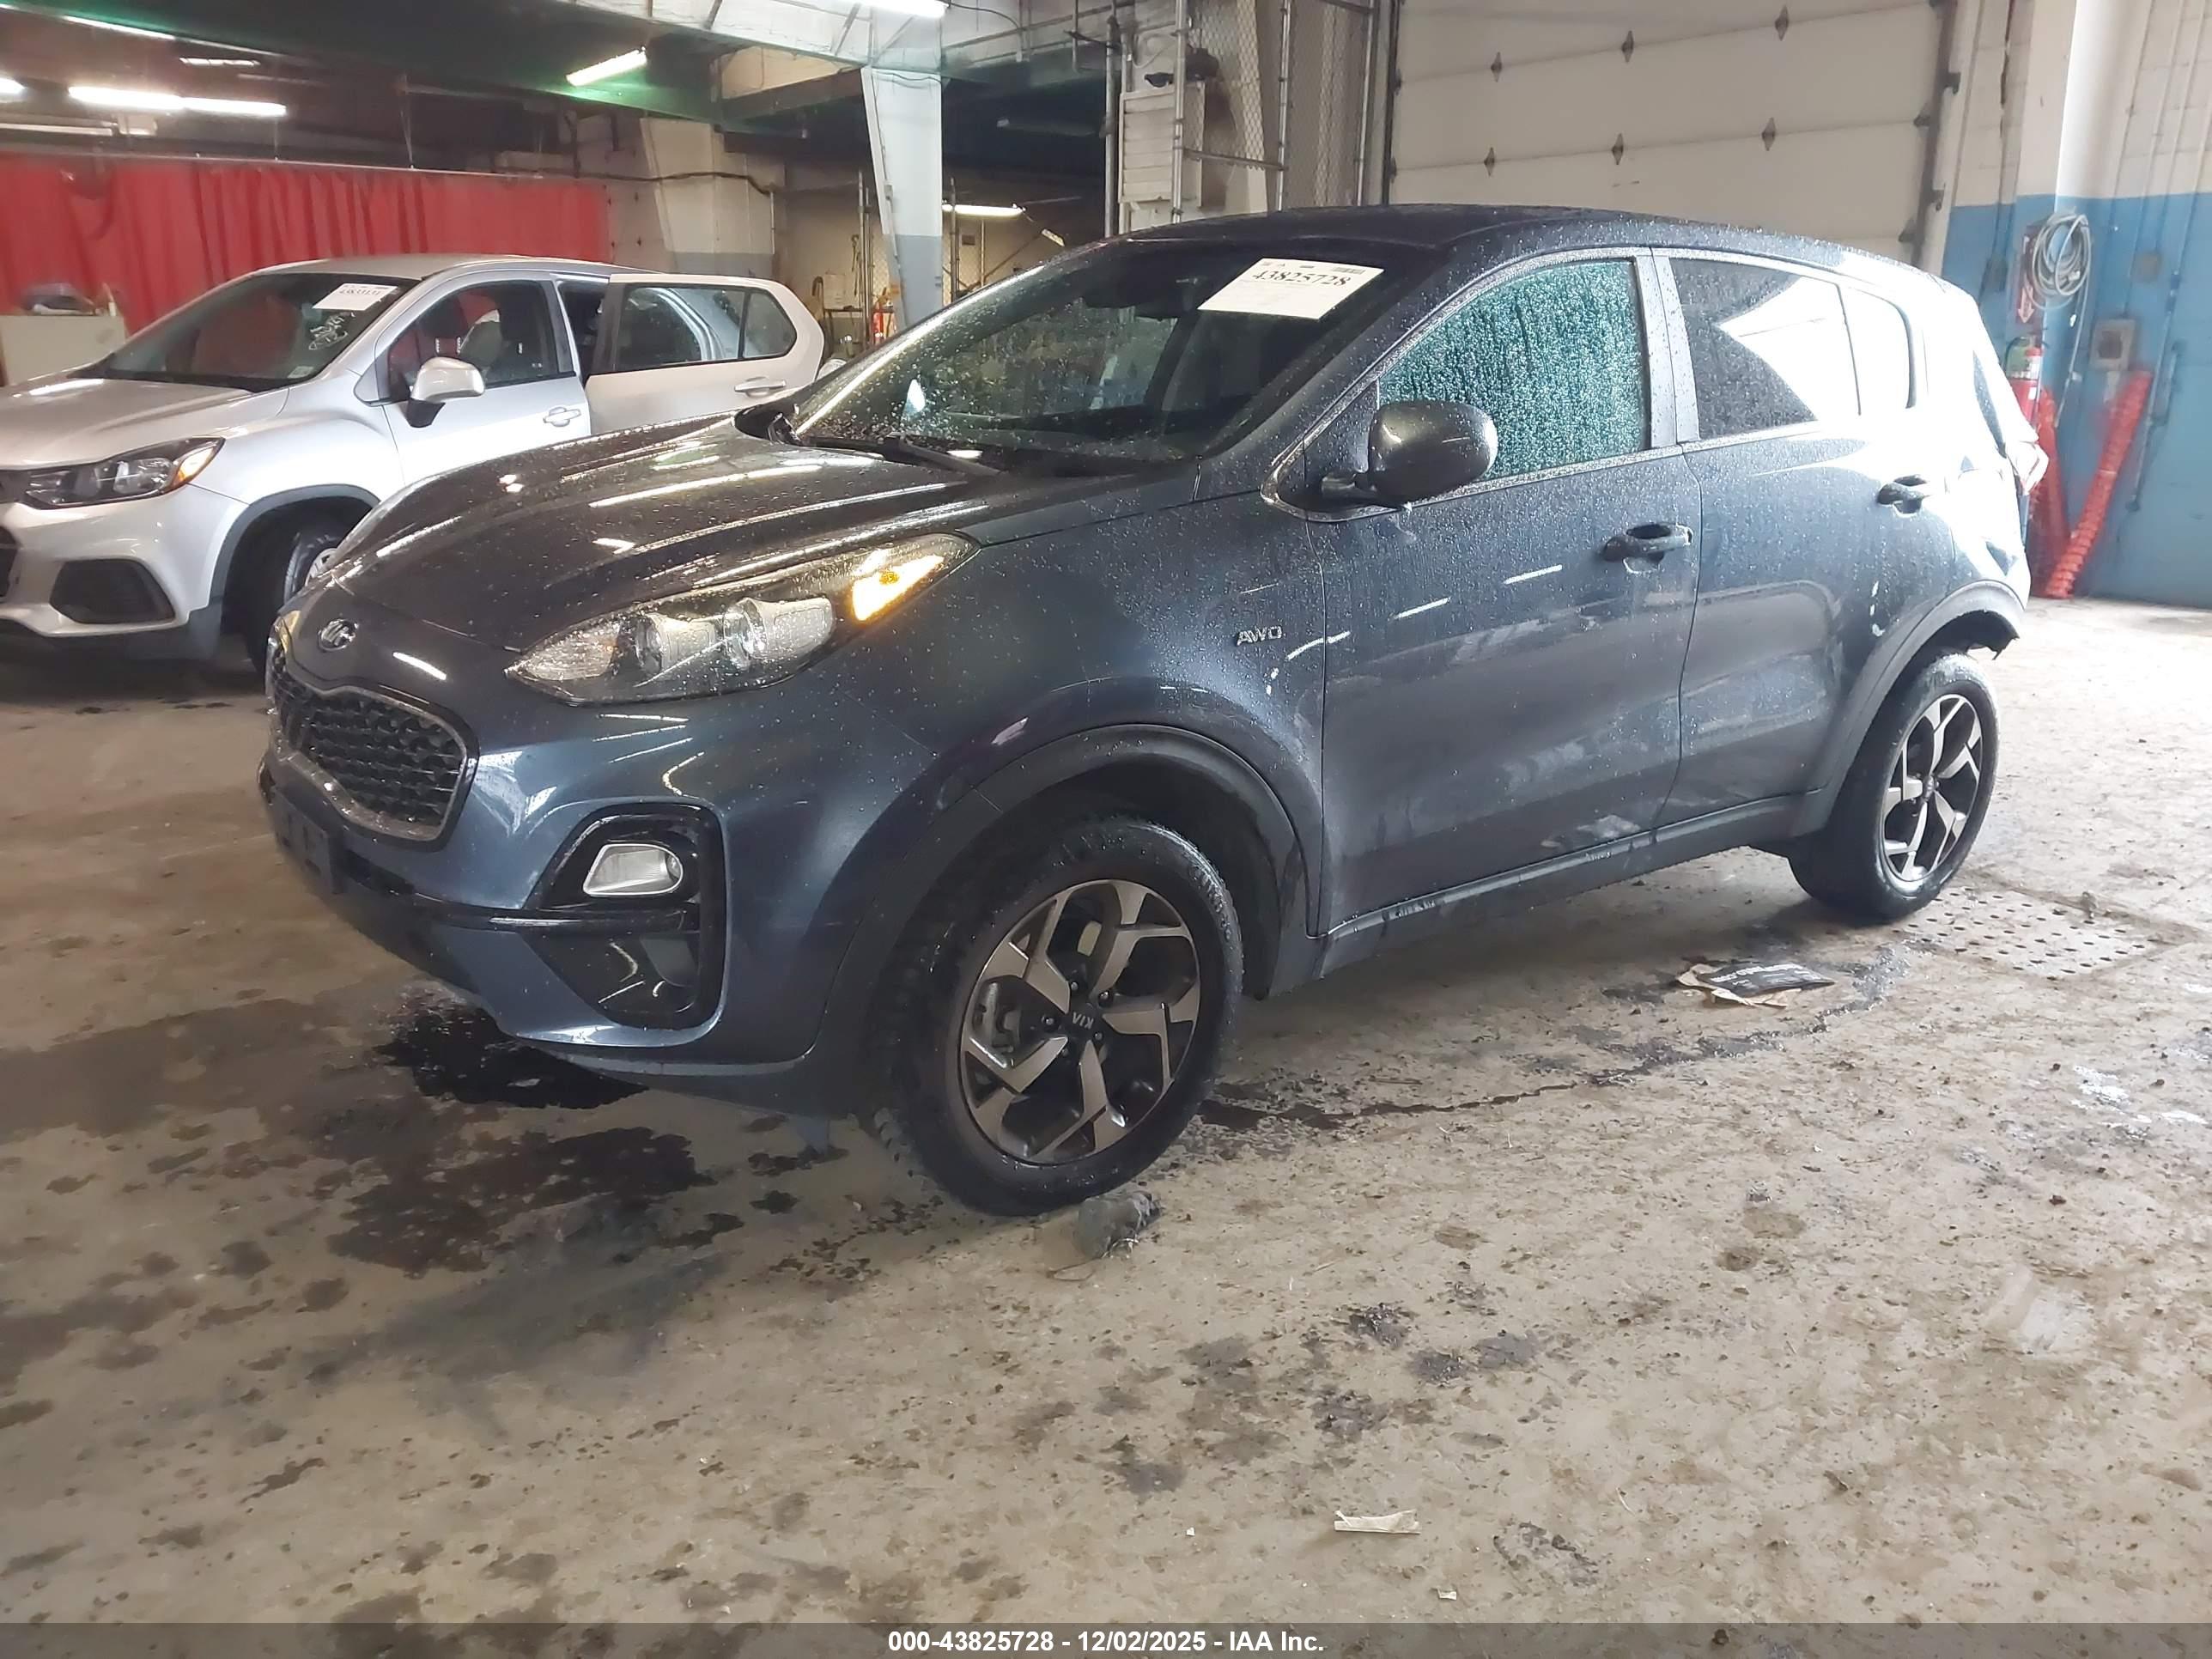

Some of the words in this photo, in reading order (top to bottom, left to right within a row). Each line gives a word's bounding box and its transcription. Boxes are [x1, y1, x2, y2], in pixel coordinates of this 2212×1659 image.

[1251, 270, 1352, 287] 43825728
[1237, 625, 1282, 646] AWD
[1072, 1012, 1095, 1030] KIA
